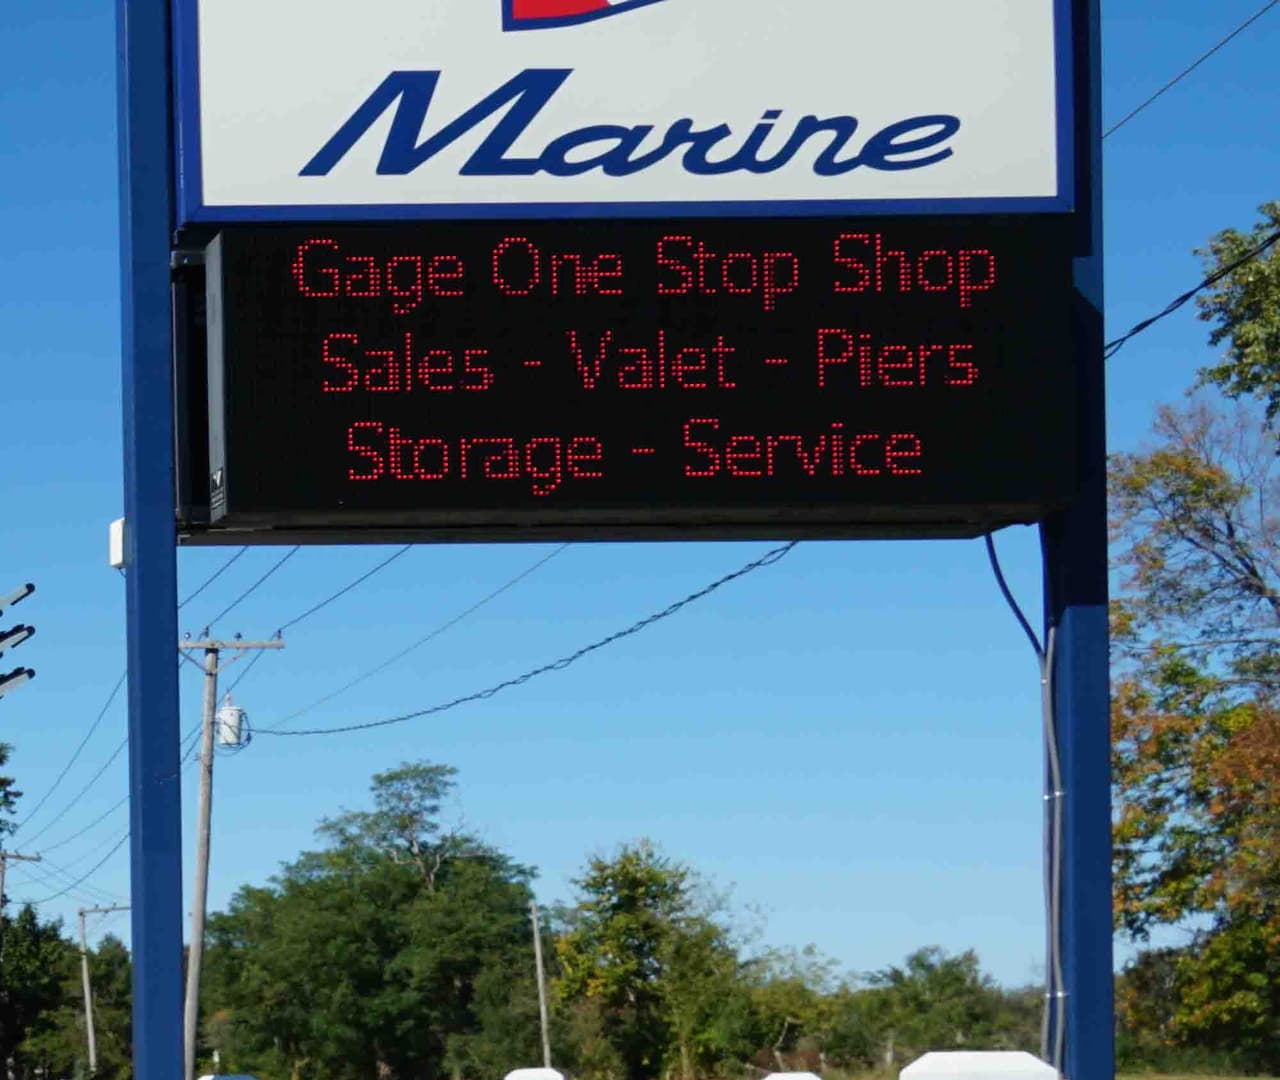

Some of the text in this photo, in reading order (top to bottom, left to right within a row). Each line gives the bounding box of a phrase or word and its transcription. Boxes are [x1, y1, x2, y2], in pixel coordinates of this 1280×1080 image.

[299, 68, 961, 177] Marine
[292, 233, 996, 314] Gage One Stop Shop
[321, 332, 494, 392] Sales
[566, 330, 736, 389] Valet
[817, 328, 979, 387] Piers
[348, 421, 603, 496] Storage
[683, 418, 922, 477] Service
